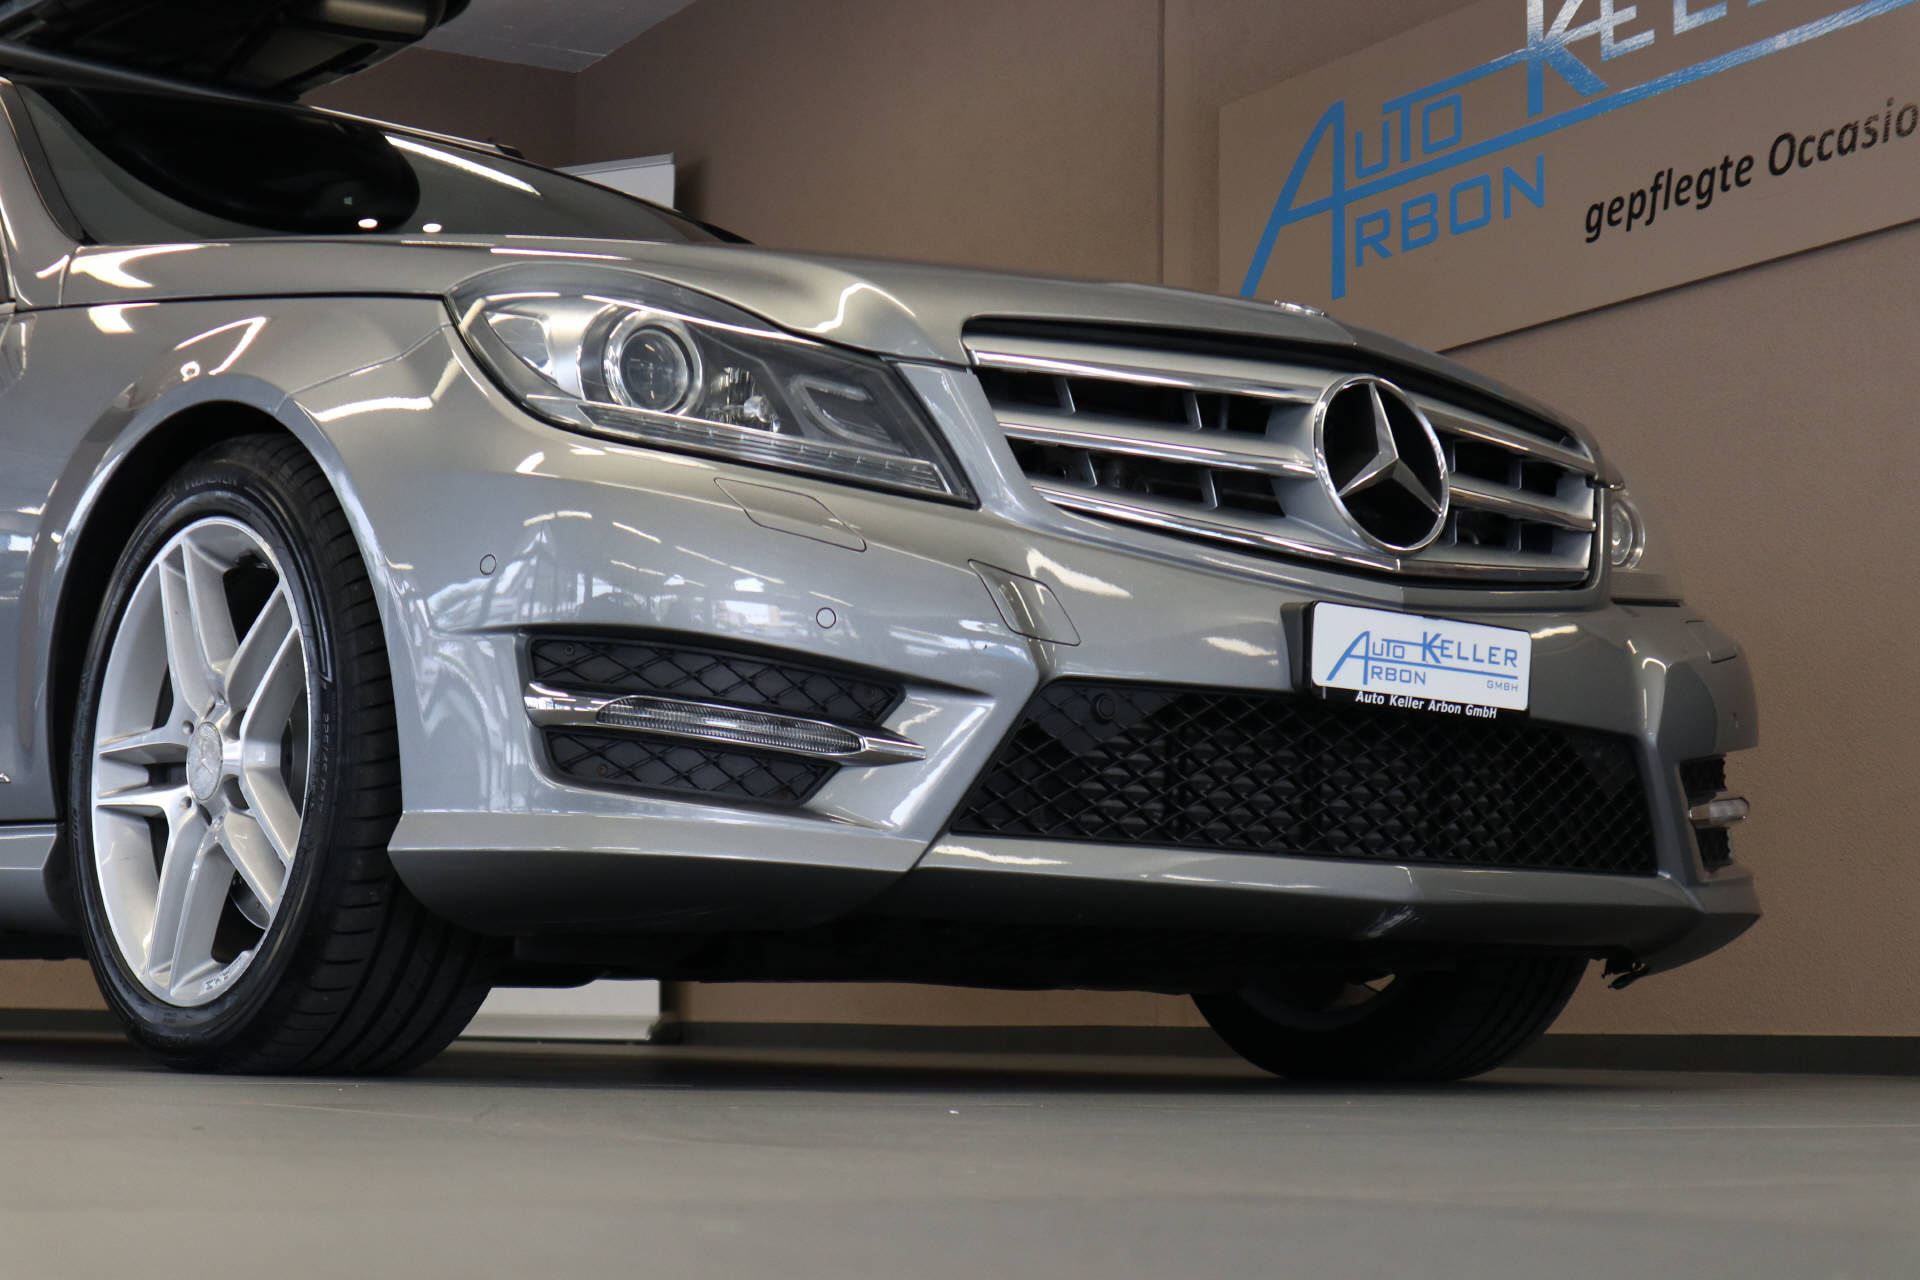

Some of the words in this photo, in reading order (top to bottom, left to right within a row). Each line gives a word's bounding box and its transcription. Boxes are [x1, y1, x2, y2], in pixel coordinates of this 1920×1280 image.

[1585, 155, 1755, 243] gepflegte
[1422, 631, 1519, 669] KELLER
[1486, 680, 1519, 693] GMBH
[1355, 691, 1385, 705] Auto
[1389, 694, 1424, 710] Keller
[1428, 699, 1461, 715] Arbon
[1465, 704, 1497, 719] GmbH
